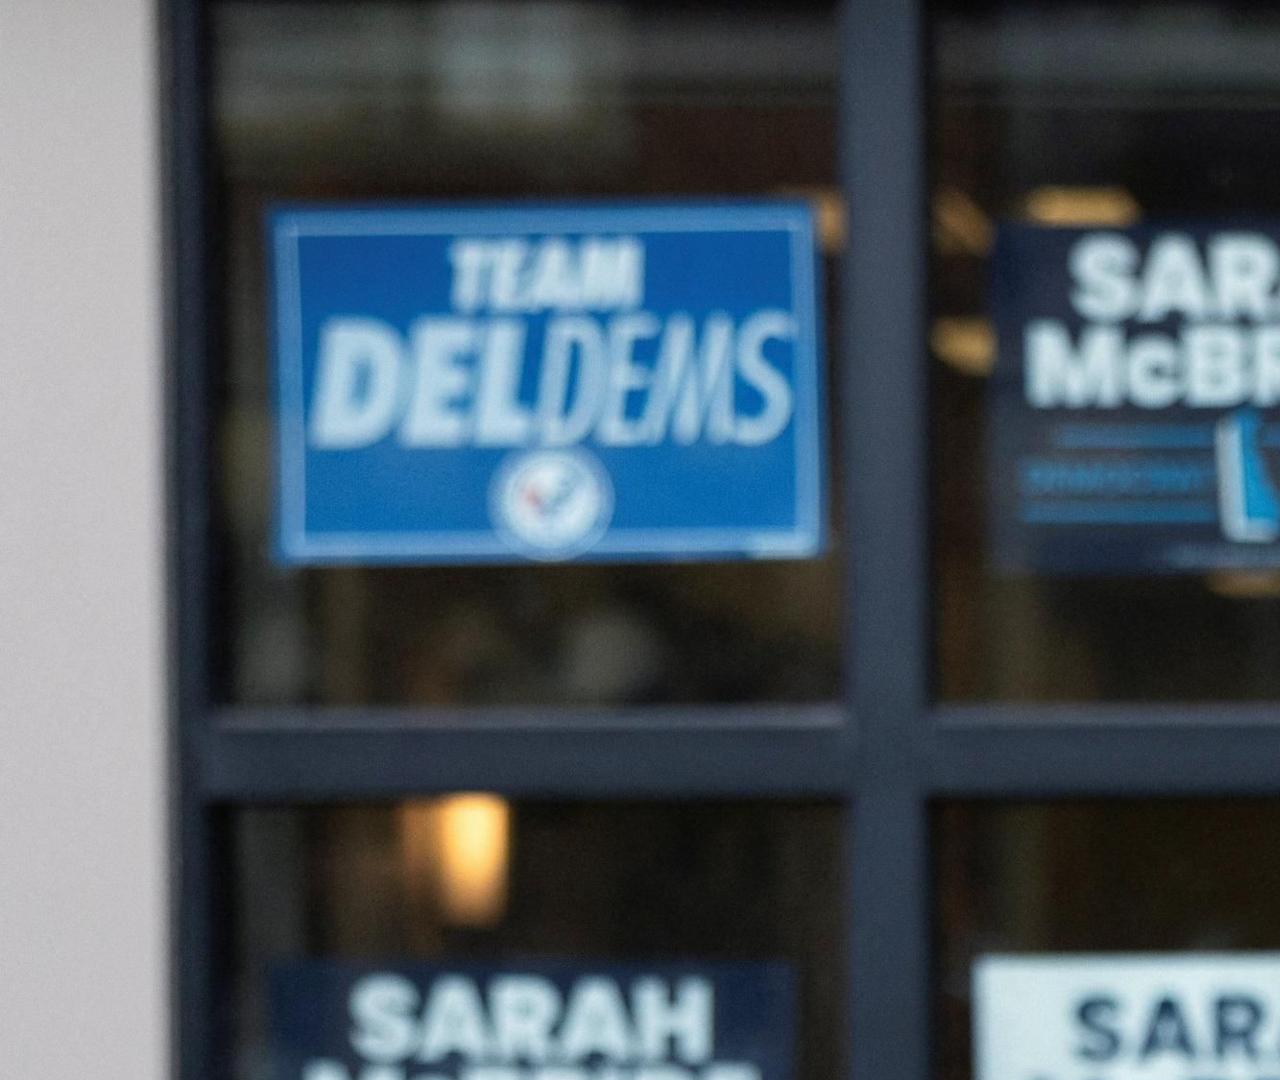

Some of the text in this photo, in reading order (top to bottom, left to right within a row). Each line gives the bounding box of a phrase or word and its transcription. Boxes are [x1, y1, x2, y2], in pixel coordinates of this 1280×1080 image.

[452, 237, 646, 314] TEAM
[310, 310, 797, 448] DELDEMS
[350, 972, 714, 1063] SARAH
